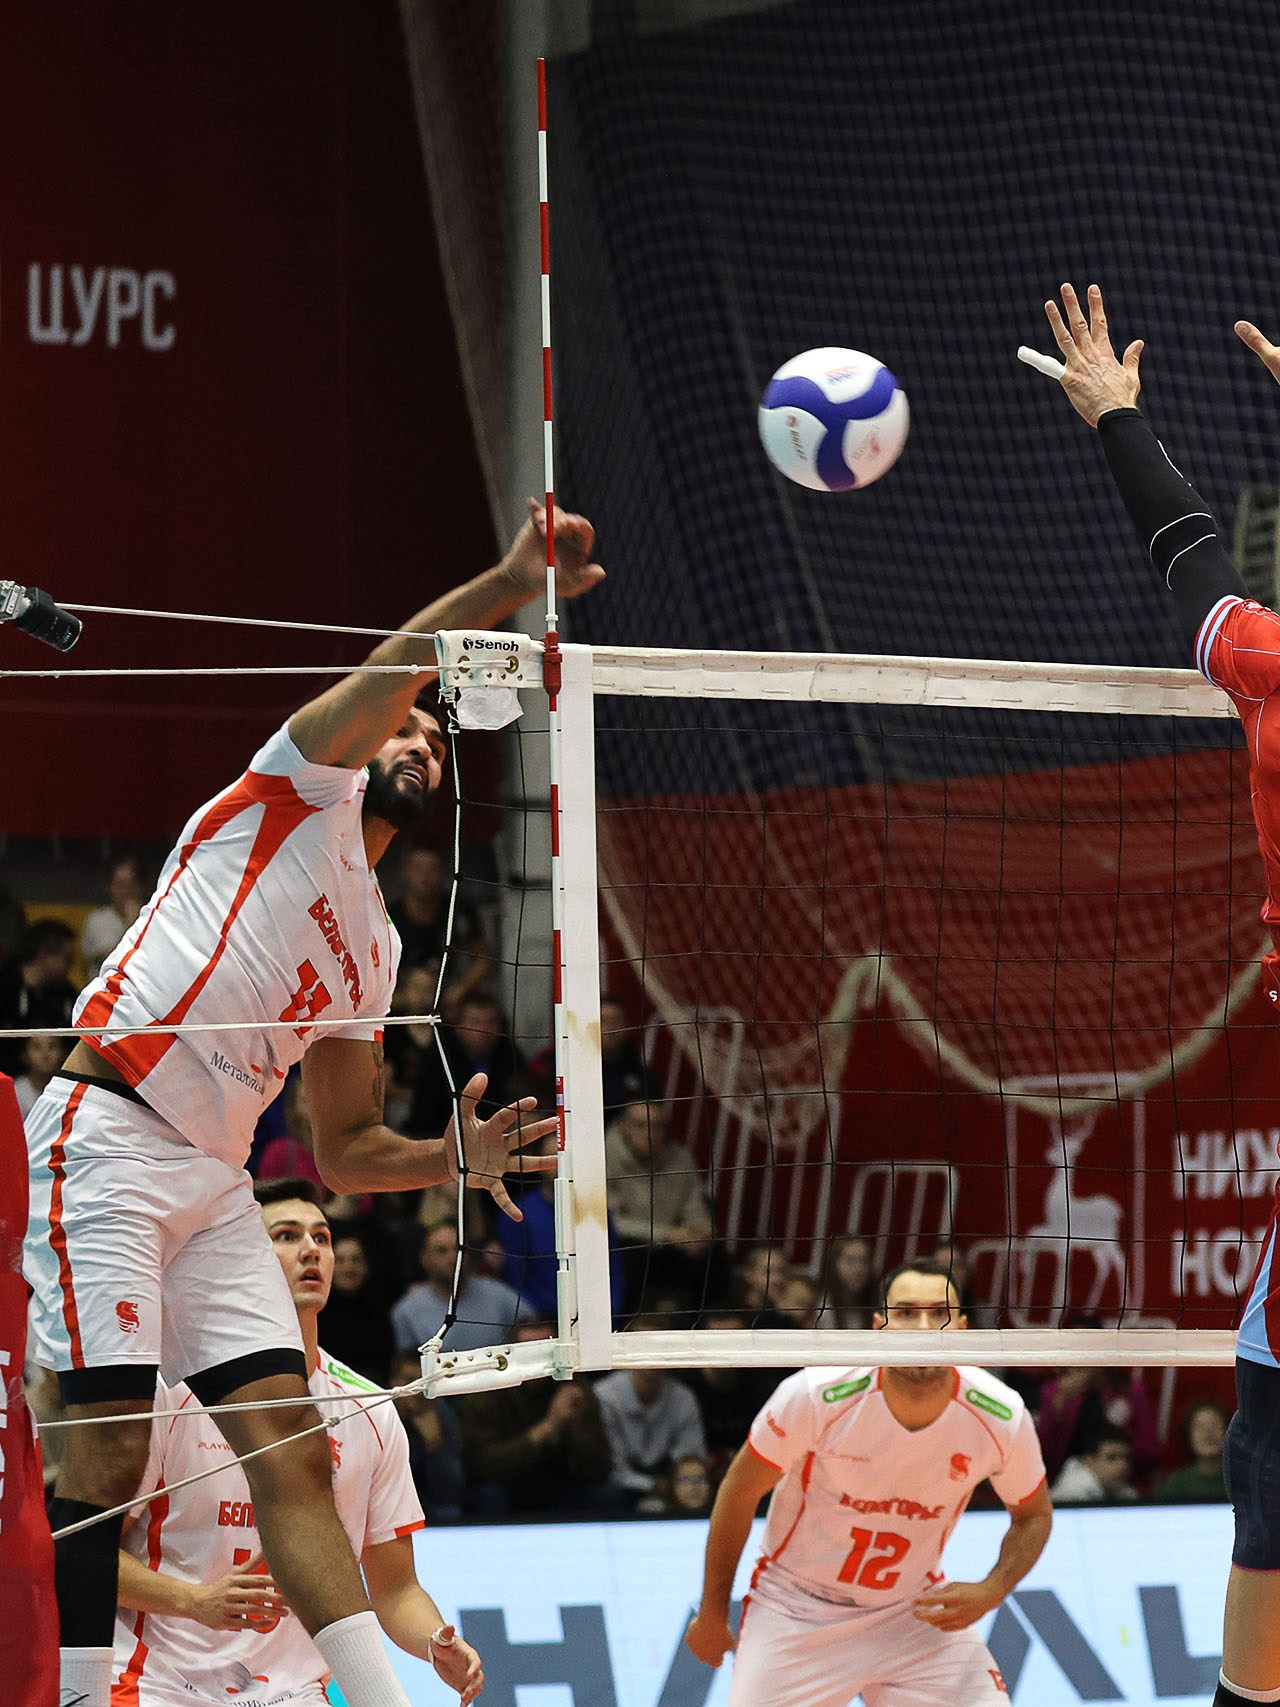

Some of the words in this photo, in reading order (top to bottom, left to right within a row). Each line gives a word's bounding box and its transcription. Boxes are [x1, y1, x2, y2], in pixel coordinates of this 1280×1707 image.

[28, 262, 176, 352] ЦУРС
[474, 640, 519, 652] Senoh
[218, 1501, 257, 1528] БЕЛ
[837, 1526, 911, 1591] 12
